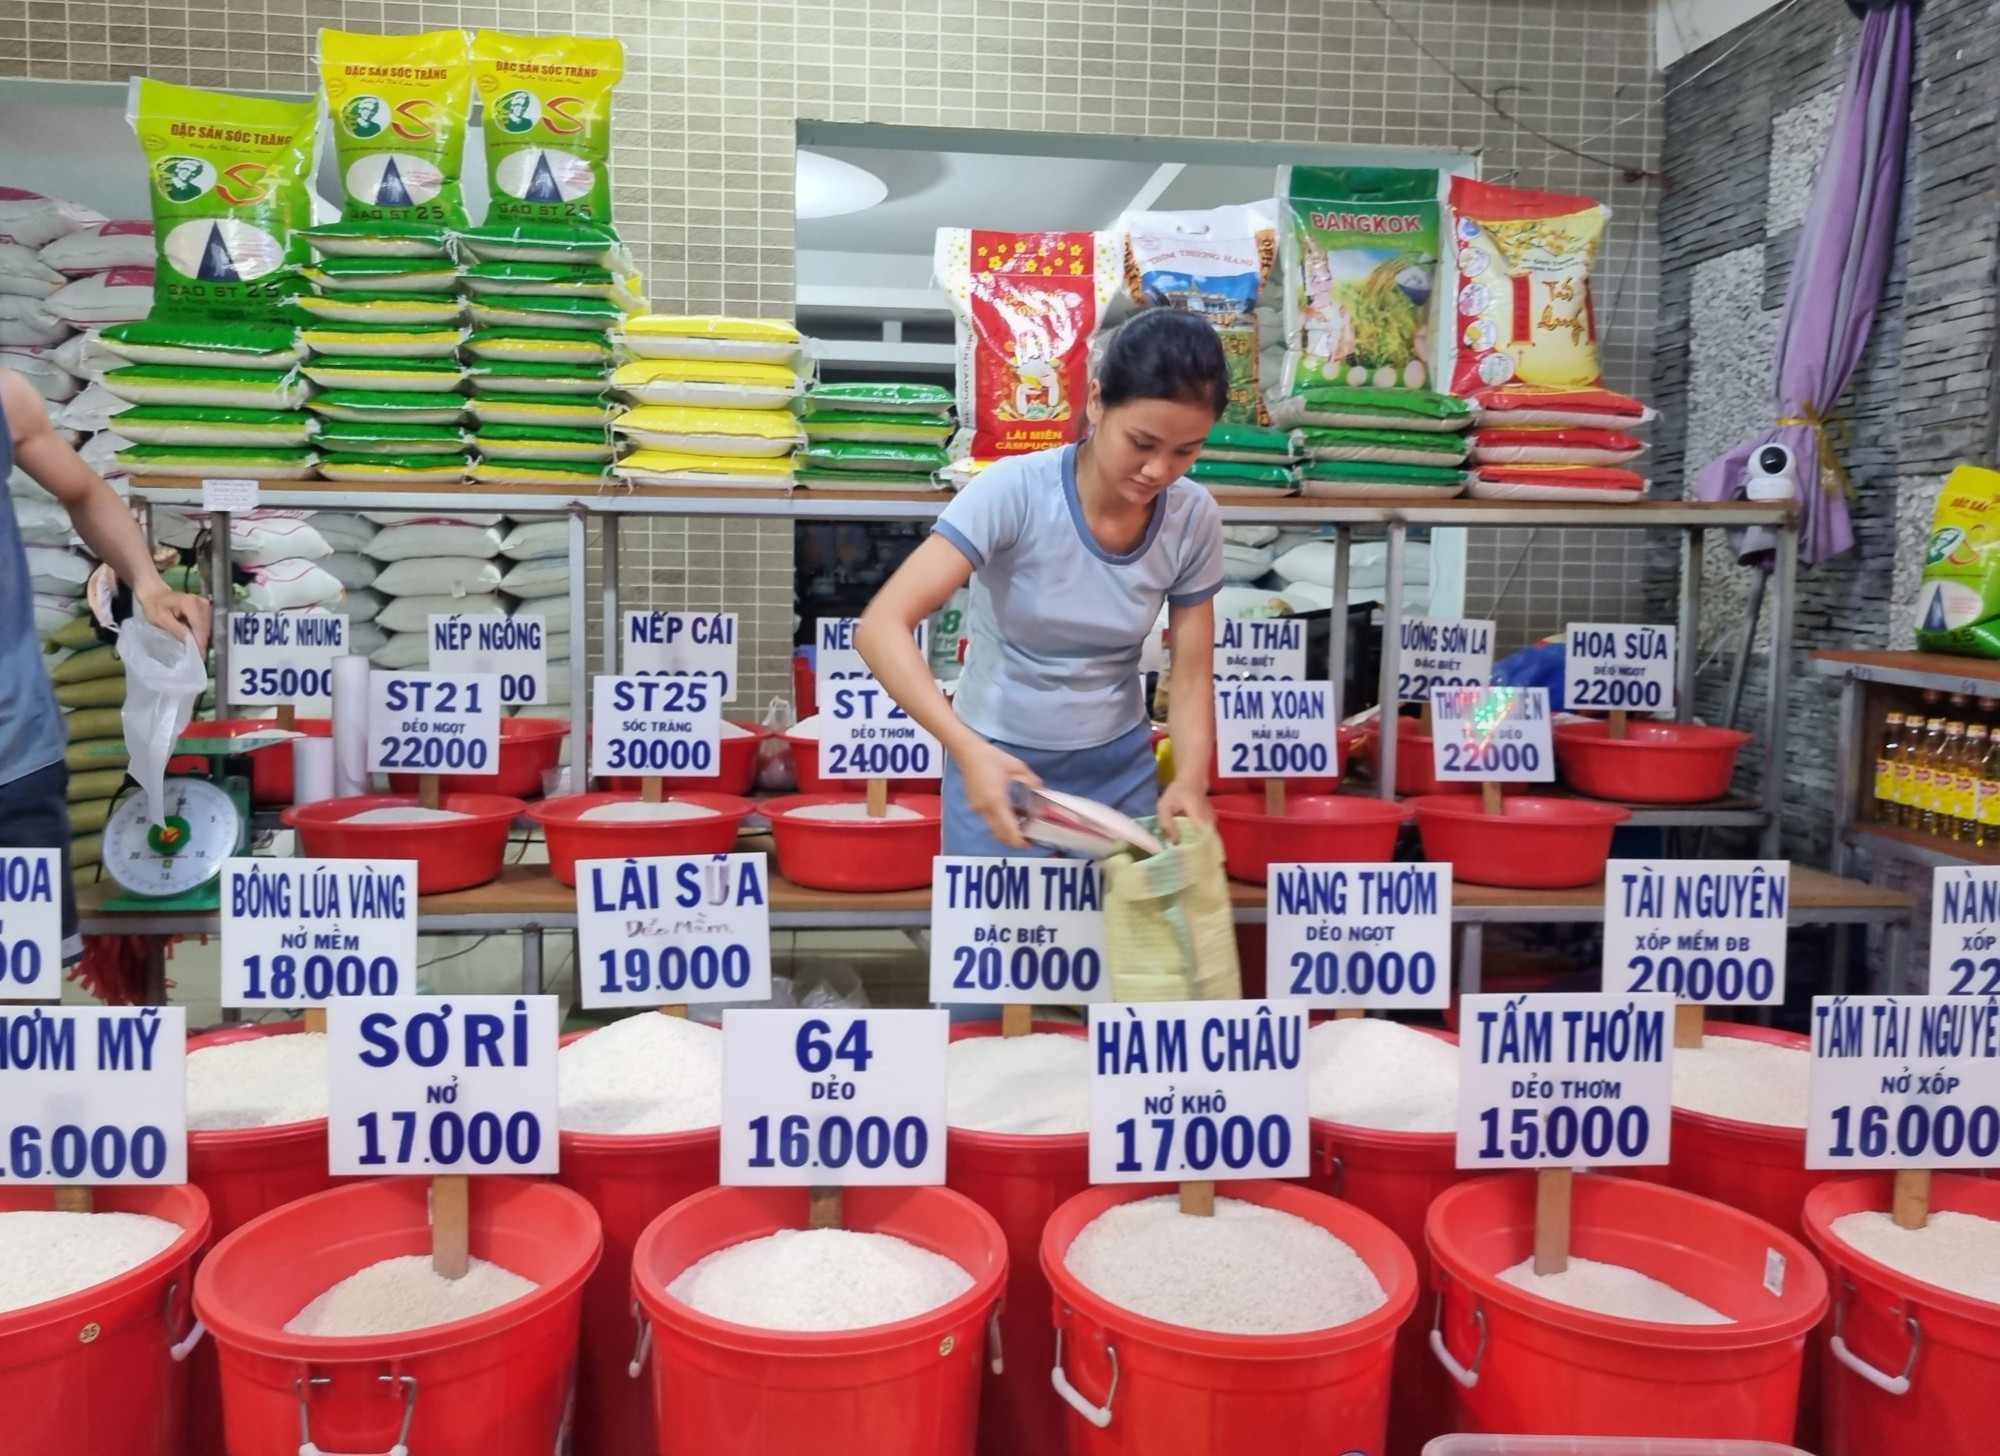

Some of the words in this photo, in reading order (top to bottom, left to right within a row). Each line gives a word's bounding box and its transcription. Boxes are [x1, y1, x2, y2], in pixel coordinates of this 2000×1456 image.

[1309, 211, 1423, 234] BANGKOK
[296, 618, 342, 646] NHUNG
[435, 613, 472, 650] NẾP
[631, 610, 683, 643] NẾP
[691, 612, 732, 644] CÁI
[1213, 617, 1242, 648] ÀI
[1250, 619, 1300, 649] THÁI
[1471, 628, 1488, 654] LA
[1572, 631, 1616, 658] HOA
[1624, 626, 1668, 660] SỮA
[612, 680, 708, 713] ST25
[1218, 683, 1264, 720] TÁM
[1270, 690, 1325, 720] XOAN
[232, 863, 291, 919] BÔNG
[300, 864, 341, 919] LÚA
[349, 864, 406, 920] VÀNG
[945, 858, 1030, 910] THƠM
[1275, 865, 1348, 915] NÀNG
[1358, 866, 1437, 915] THƠM
[1622, 866, 1665, 918] TÀI
[1673, 866, 1786, 919] NGUYÊN
[1943, 869, 2000, 924] NÀN
[281, 924, 308, 949] NỞ
[314, 922, 360, 950] MỀM
[974, 923, 1013, 947] ĐẶC
[1016, 924, 1059, 948] BIỆT
[1306, 919, 1342, 941] DẺO
[1347, 926, 1396, 947] NGỌT
[1725, 936, 1752, 951] ĐB
[243, 954, 399, 1000] 18.000
[598, 943, 751, 993] 19.000
[953, 945, 1102, 992] 20.000
[1289, 951, 1437, 996] 20.000
[1626, 955, 1775, 1002] 20.000
[98, 1007, 162, 1071] MỸ
[795, 1018, 873, 1074] 64
[1096, 1006, 1188, 1076] HÀM
[1201, 1004, 1303, 1073] CHÂU
[1476, 994, 1553, 1064] TẤM
[1561, 1001, 1666, 1064] THƠM
[1815, 995, 1864, 1059] TẤM
[1872, 996, 1912, 1059] TÀI
[1918, 995, 2000, 1059] NGUYÊ
[426, 1073, 460, 1104] NỞ
[810, 1074, 856, 1101] DẺO
[1143, 1085, 1176, 1115] NỞ
[1181, 1088, 1227, 1115] KHÔ
[1511, 1072, 1554, 1100] DẺO
[1561, 1078, 1623, 1100] THƠM
[1880, 1065, 1914, 1095] NỞ
[1916, 1065, 1961, 1096] XỐP
[0, 1124, 167, 1179] 6.000
[356, 1110, 542, 1166] 17.000
[747, 1113, 929, 1169] 16.000
[1115, 1113, 1292, 1173] 17.000
[1478, 1104, 1650, 1161] 15.000
[1828, 1103, 2000, 1158] 16.000
